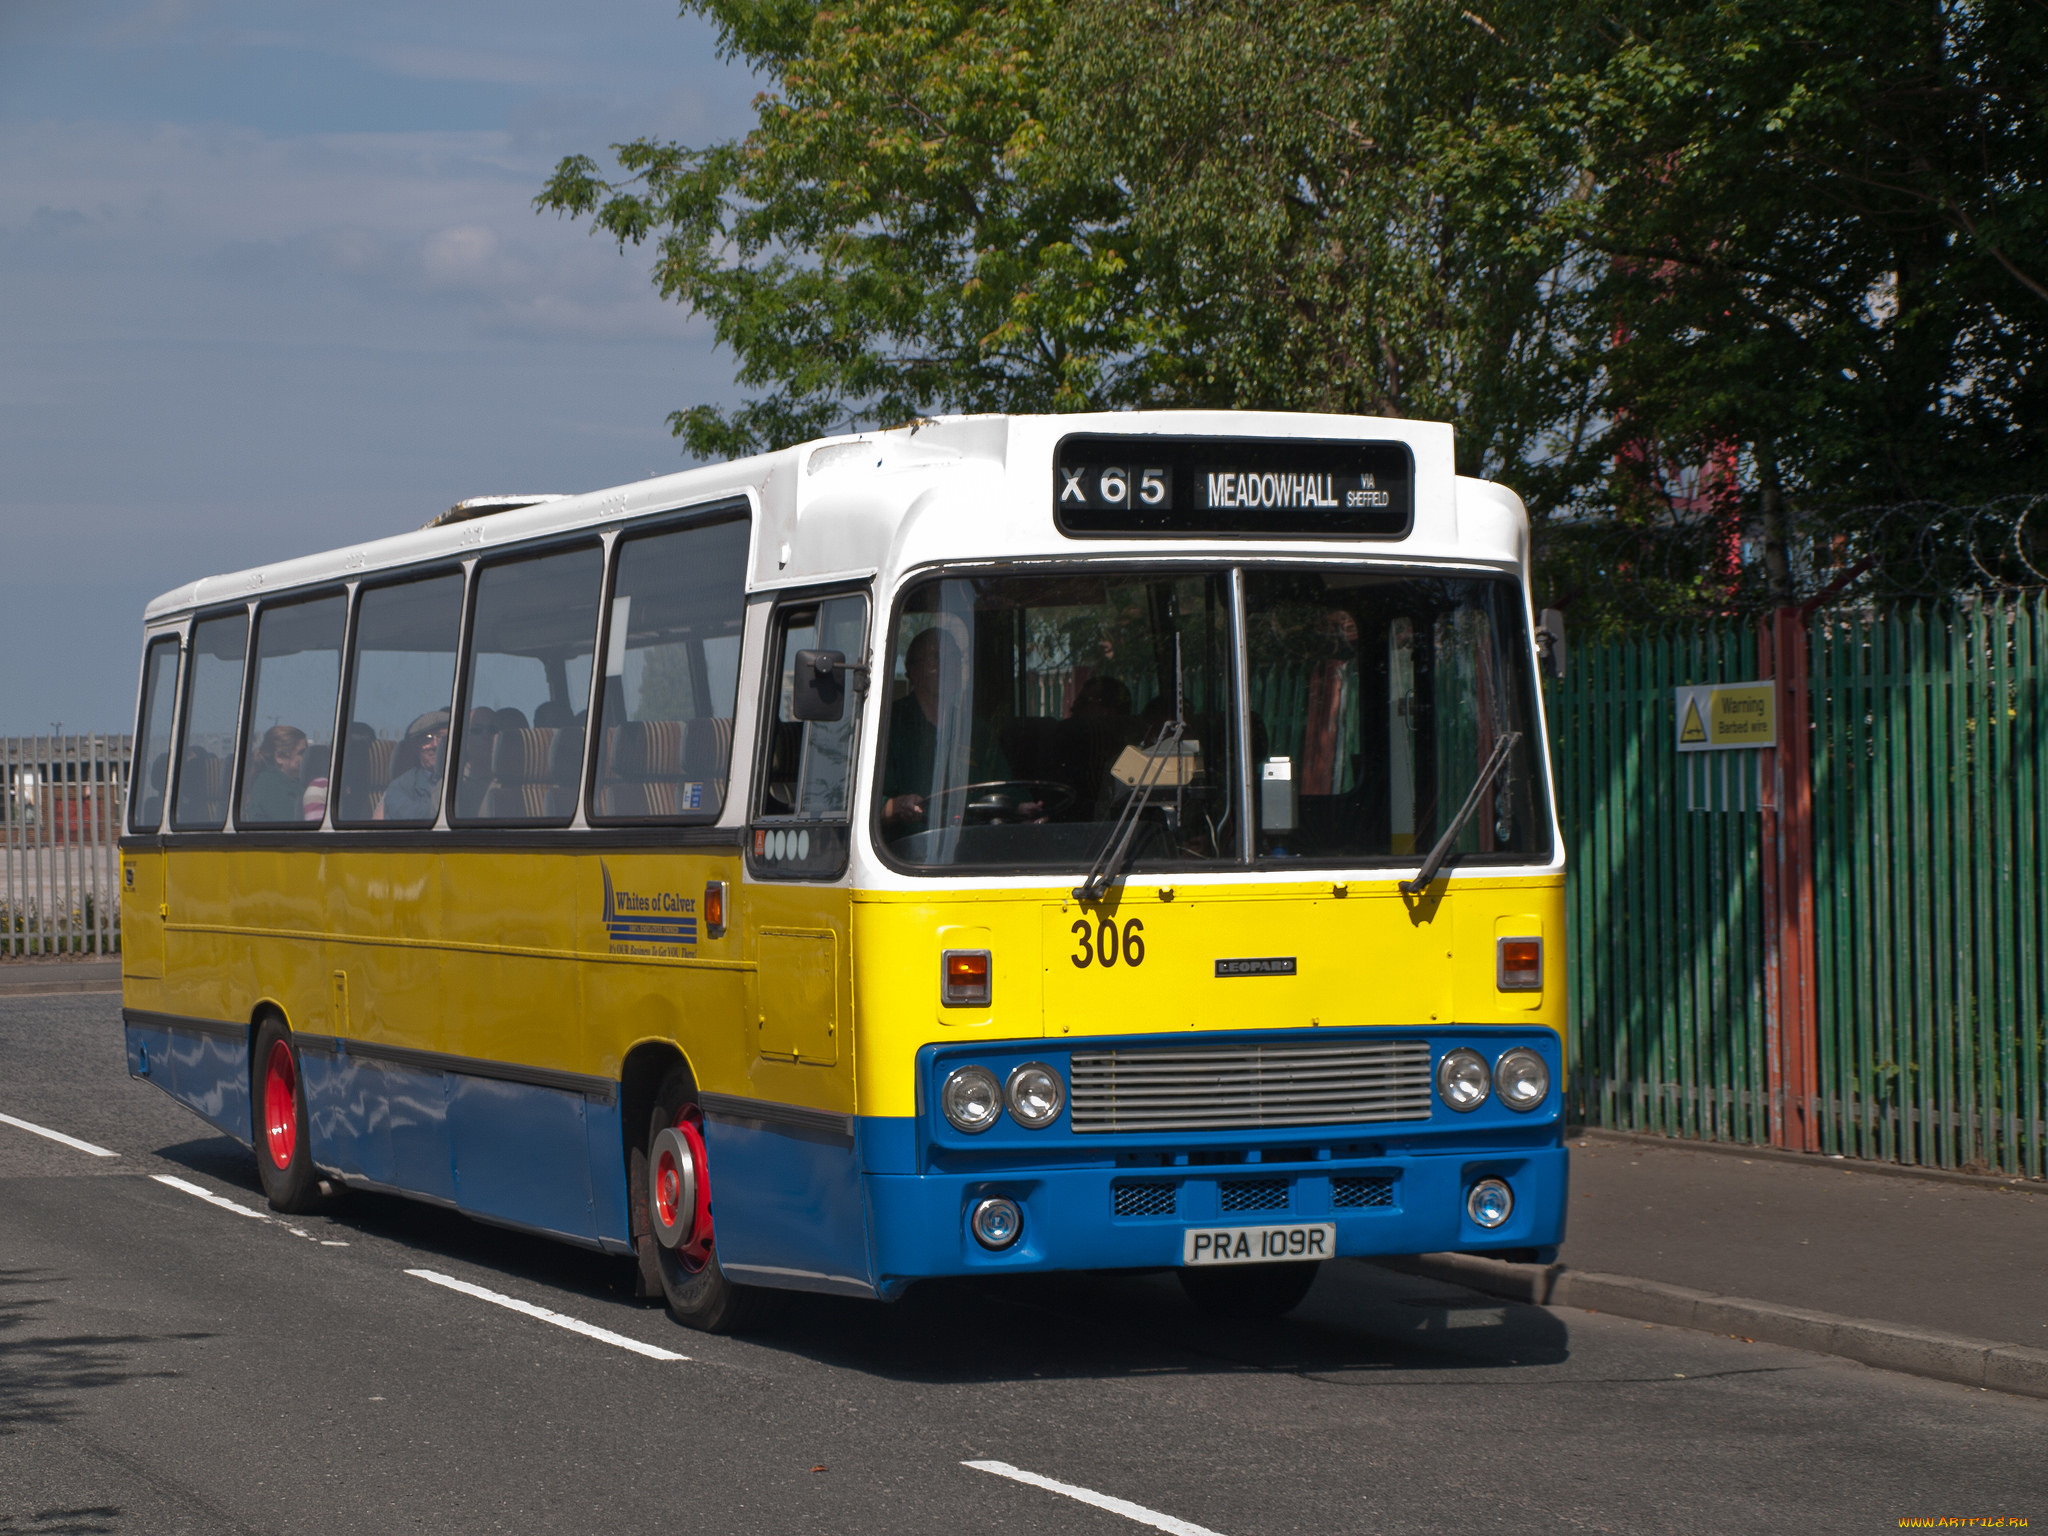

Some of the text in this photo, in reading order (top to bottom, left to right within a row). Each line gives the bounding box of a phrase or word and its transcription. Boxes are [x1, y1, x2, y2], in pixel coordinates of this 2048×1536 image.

[1208, 472, 1338, 508] MEADOWHALL
[1360, 474, 1375, 488] VIA
[1346, 490, 1389, 508] SHEFFIELD
[1722, 696, 1765, 716] Warning
[1718, 720, 1768, 735] Barbed wire
[616, 891, 696, 912] Whites of Calver
[1071, 917, 1145, 969] 306
[1218, 961, 1293, 973] LEOPARD
[1193, 1228, 1325, 1260] PRA 109R
